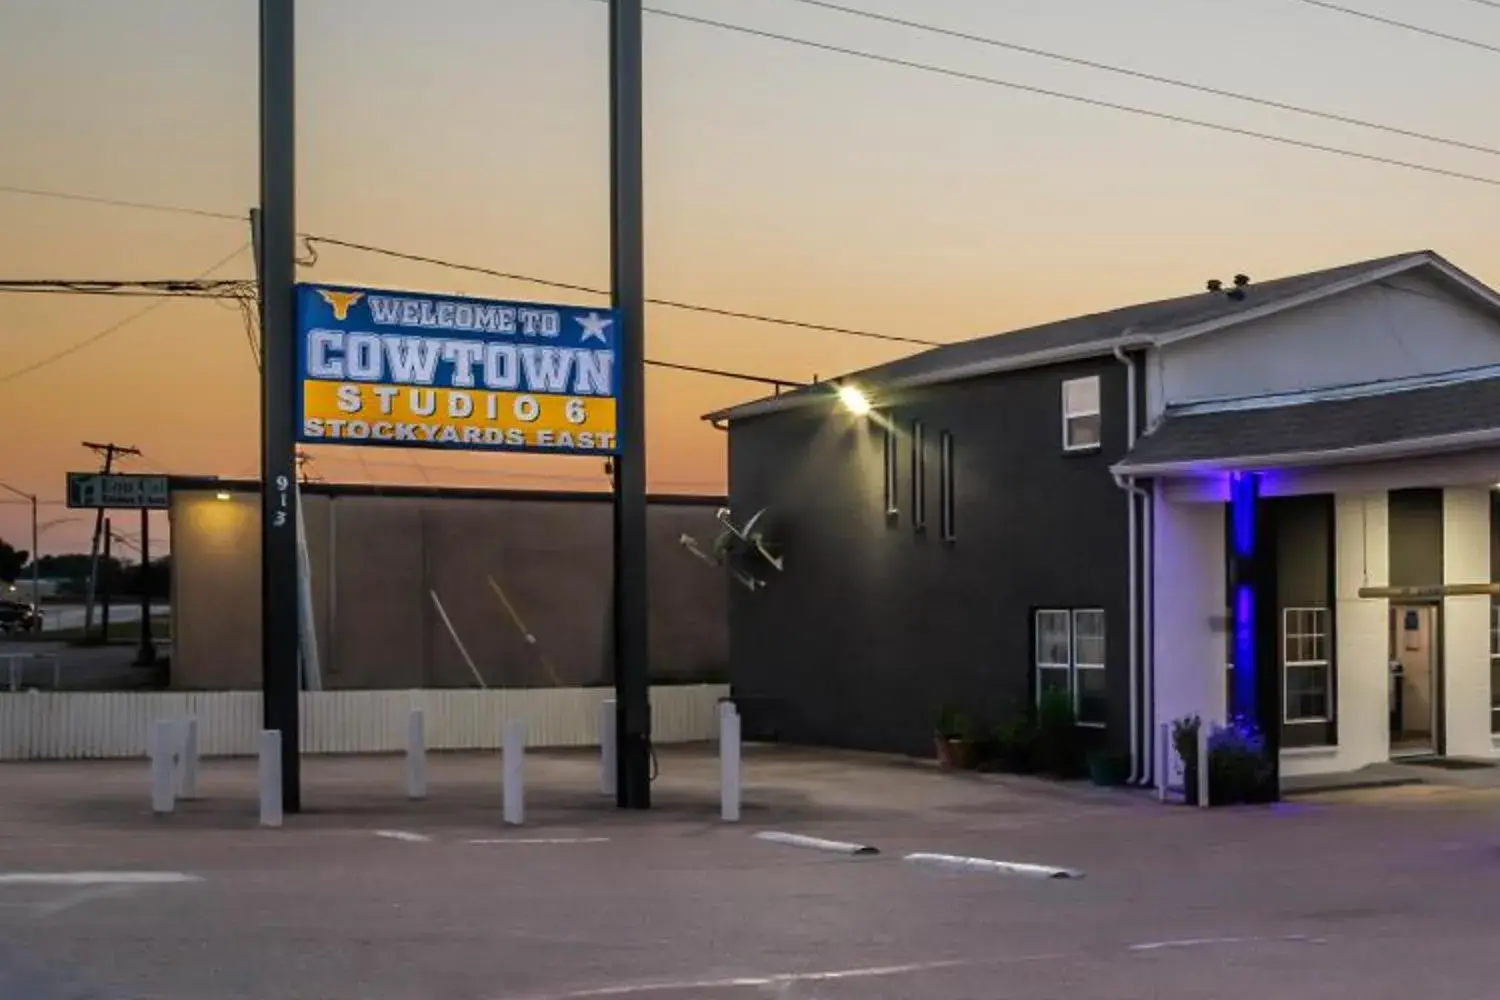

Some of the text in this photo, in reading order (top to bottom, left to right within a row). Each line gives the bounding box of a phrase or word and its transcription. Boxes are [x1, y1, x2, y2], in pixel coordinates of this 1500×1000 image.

[368, 296, 561, 337] WELCOME TO
[308, 330, 615, 395] COWTOWN
[336, 384, 587, 424] STUDIO 6
[304, 419, 616, 450] STOCKYARDS EAST
[273, 474, 289, 527] 913
